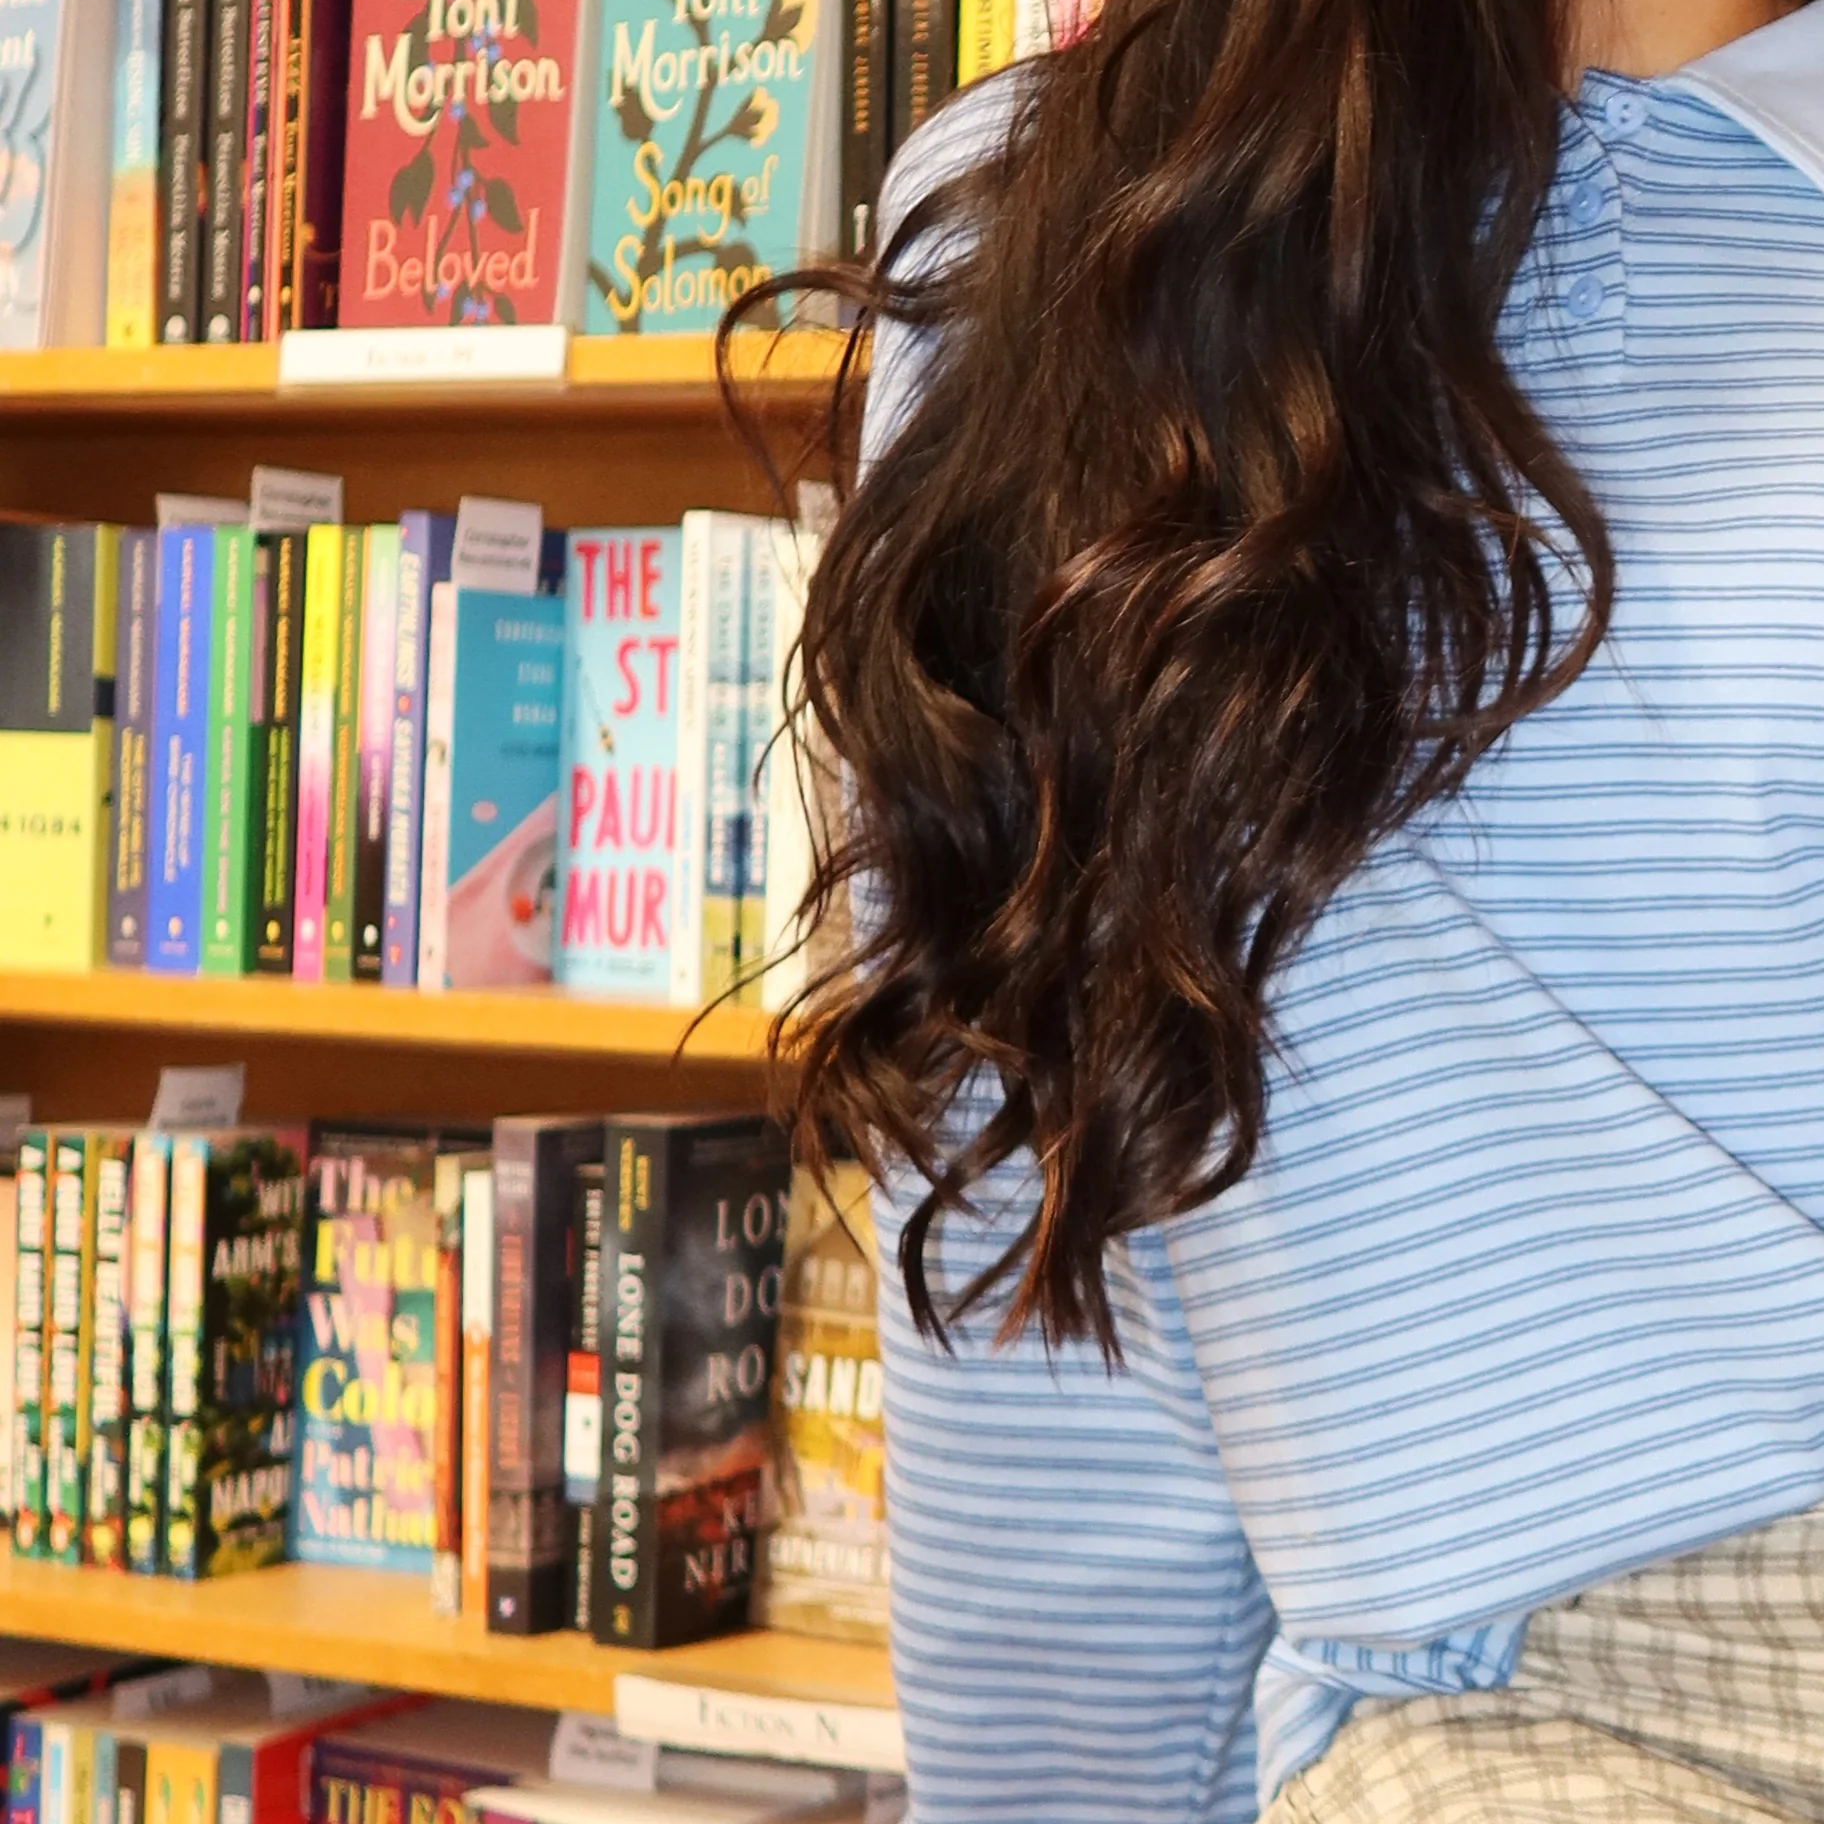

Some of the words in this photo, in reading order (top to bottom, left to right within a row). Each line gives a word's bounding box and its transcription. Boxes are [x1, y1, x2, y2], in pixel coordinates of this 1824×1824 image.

[360, 31, 566, 138] Morrison
[607, 19, 803, 122] Morrison
[625, 141, 735, 245] Song
[740, 154, 779, 214] of
[362, 208, 541, 303] Beloved
[606, 234, 774, 321] Solomon
[574, 540, 662, 624] THE
[612, 635, 680, 720] ST
[560, 867, 668, 950] MUR
[306, 1291, 421, 1354] Was
[615, 1252, 646, 1363] LONE
[614, 1372, 642, 1465] DOG
[706, 1343, 767, 1404] RO
[610, 1475, 639, 1590] ROAD
[697, 1695, 796, 1735] FICTION
[814, 1707, 840, 1746] N
